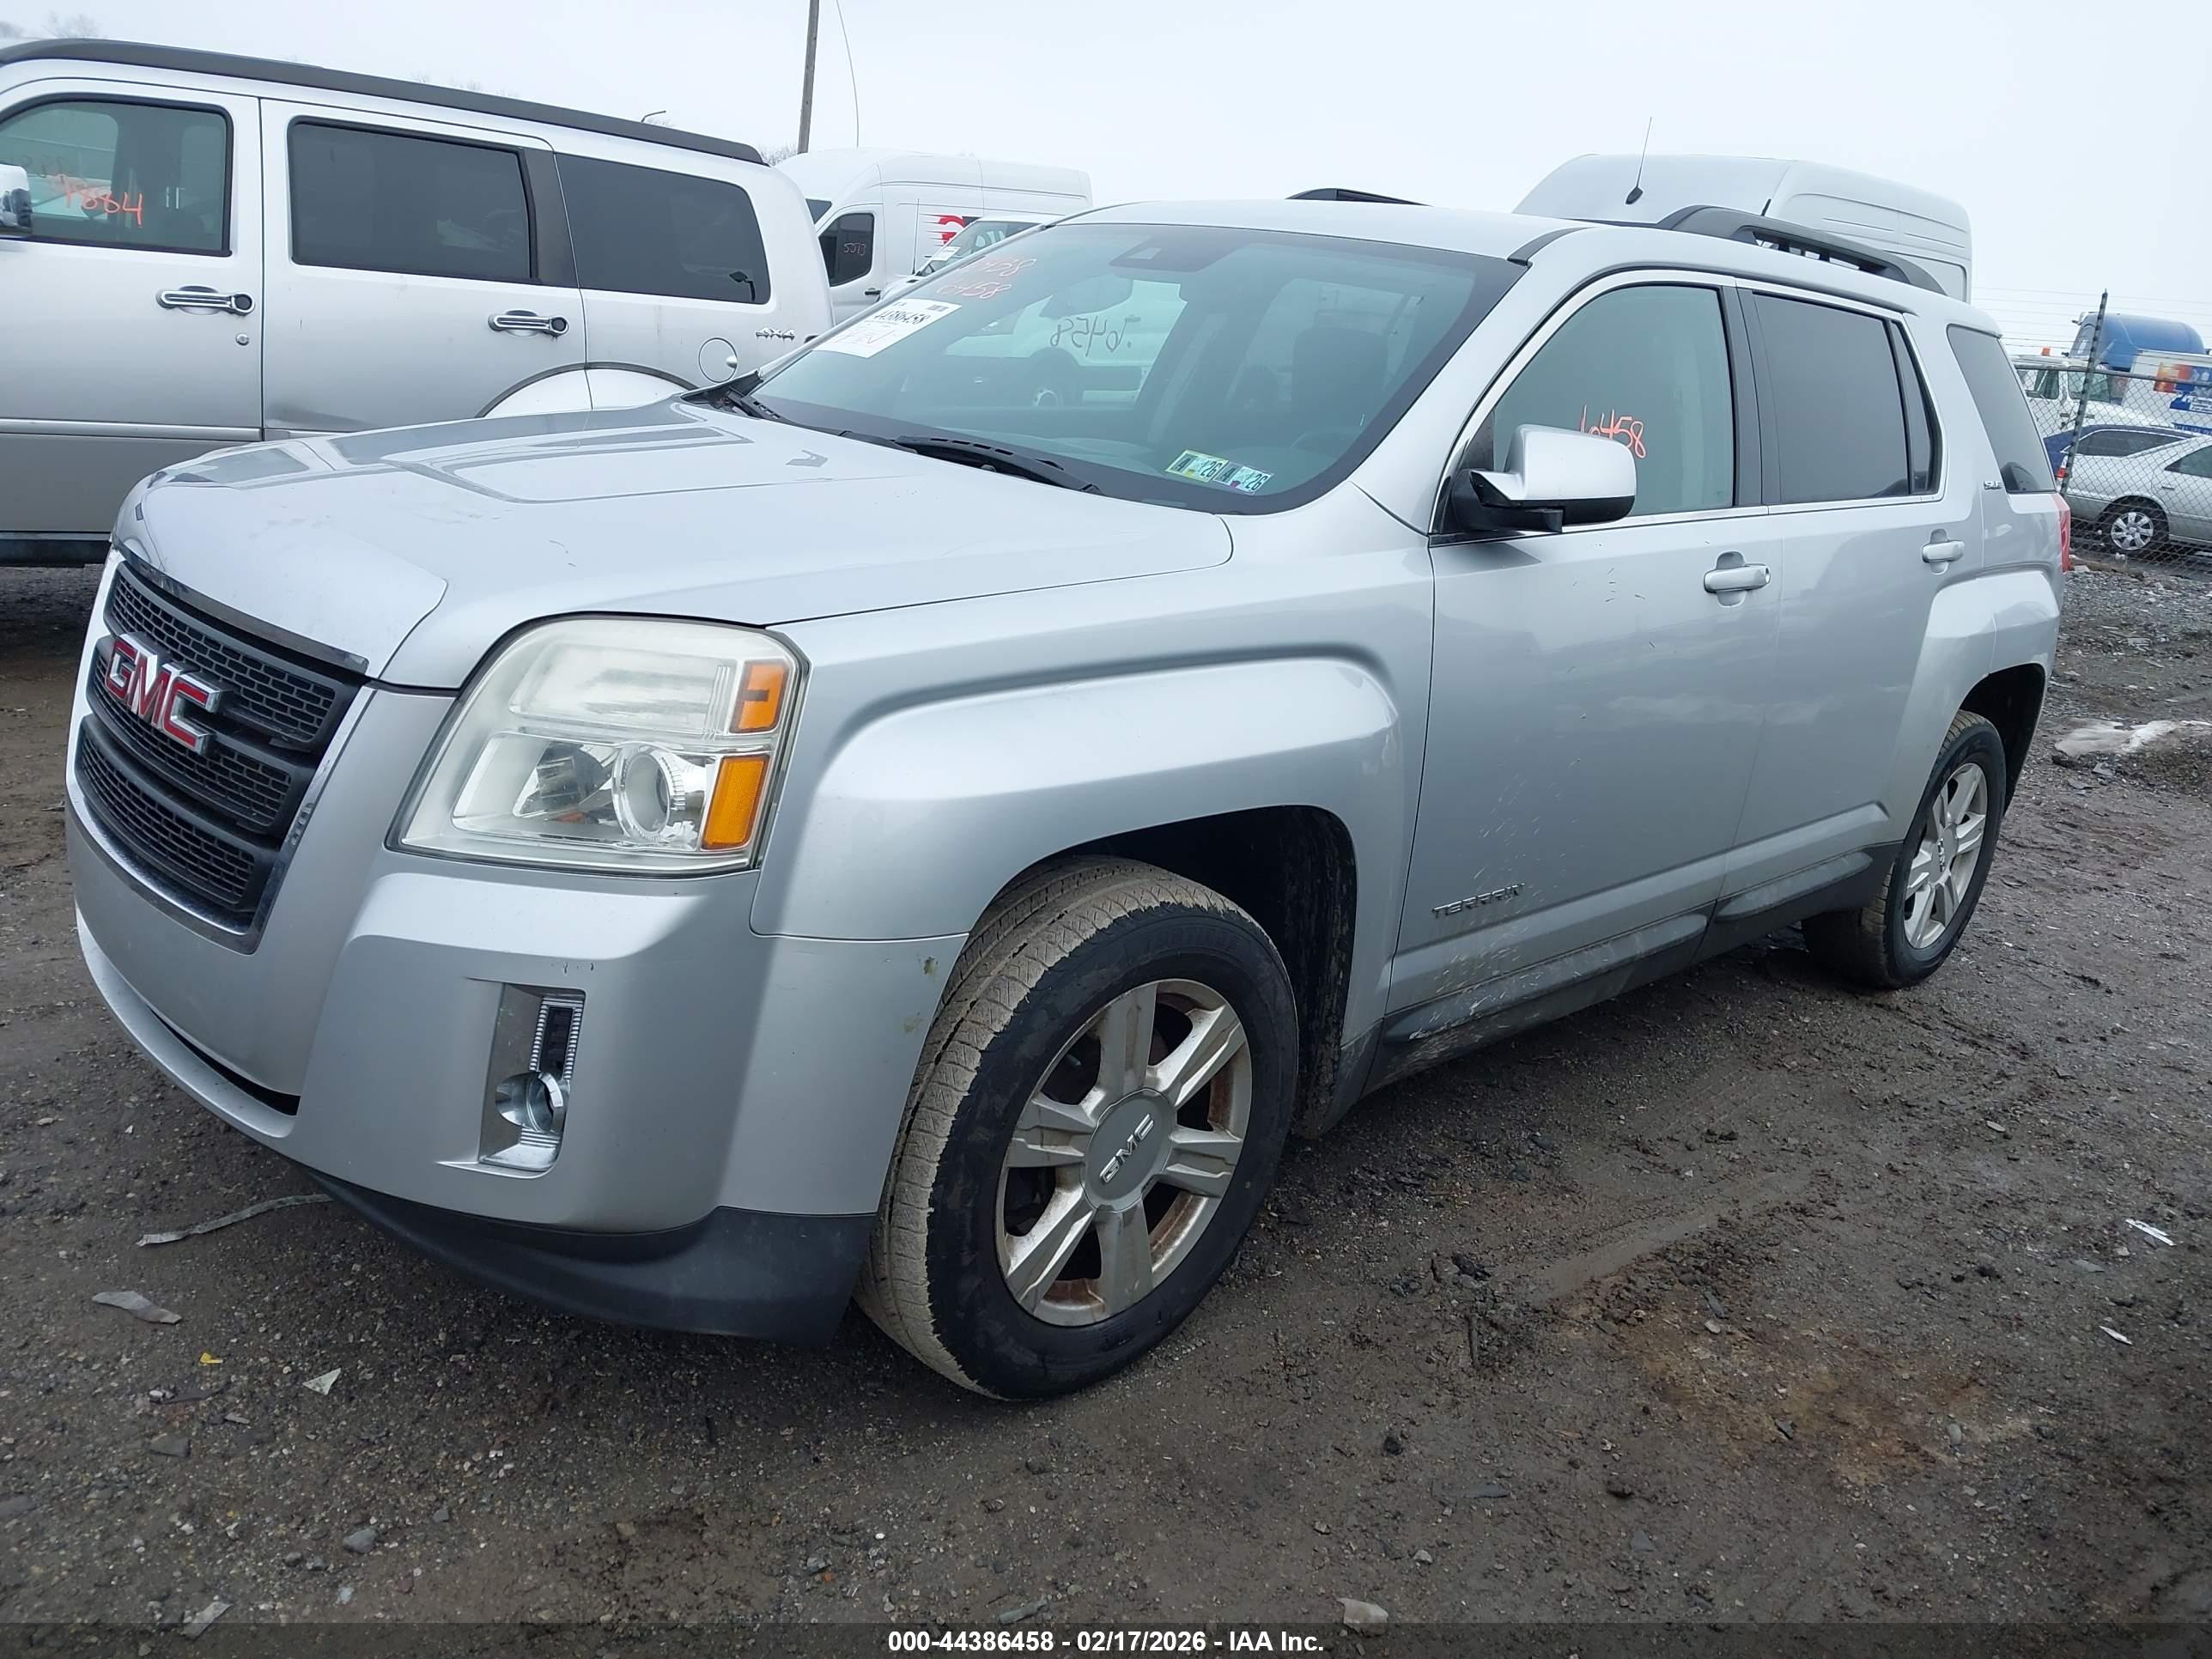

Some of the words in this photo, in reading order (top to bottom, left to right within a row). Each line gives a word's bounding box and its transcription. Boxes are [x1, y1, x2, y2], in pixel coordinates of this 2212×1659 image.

[1200, 460, 1224, 477] 26
[1245, 473, 1268, 491] 26
[105, 633, 221, 756] GMC
[1431, 882, 1526, 918] TERRAIN
[1099, 1114, 1154, 1184] GMC
